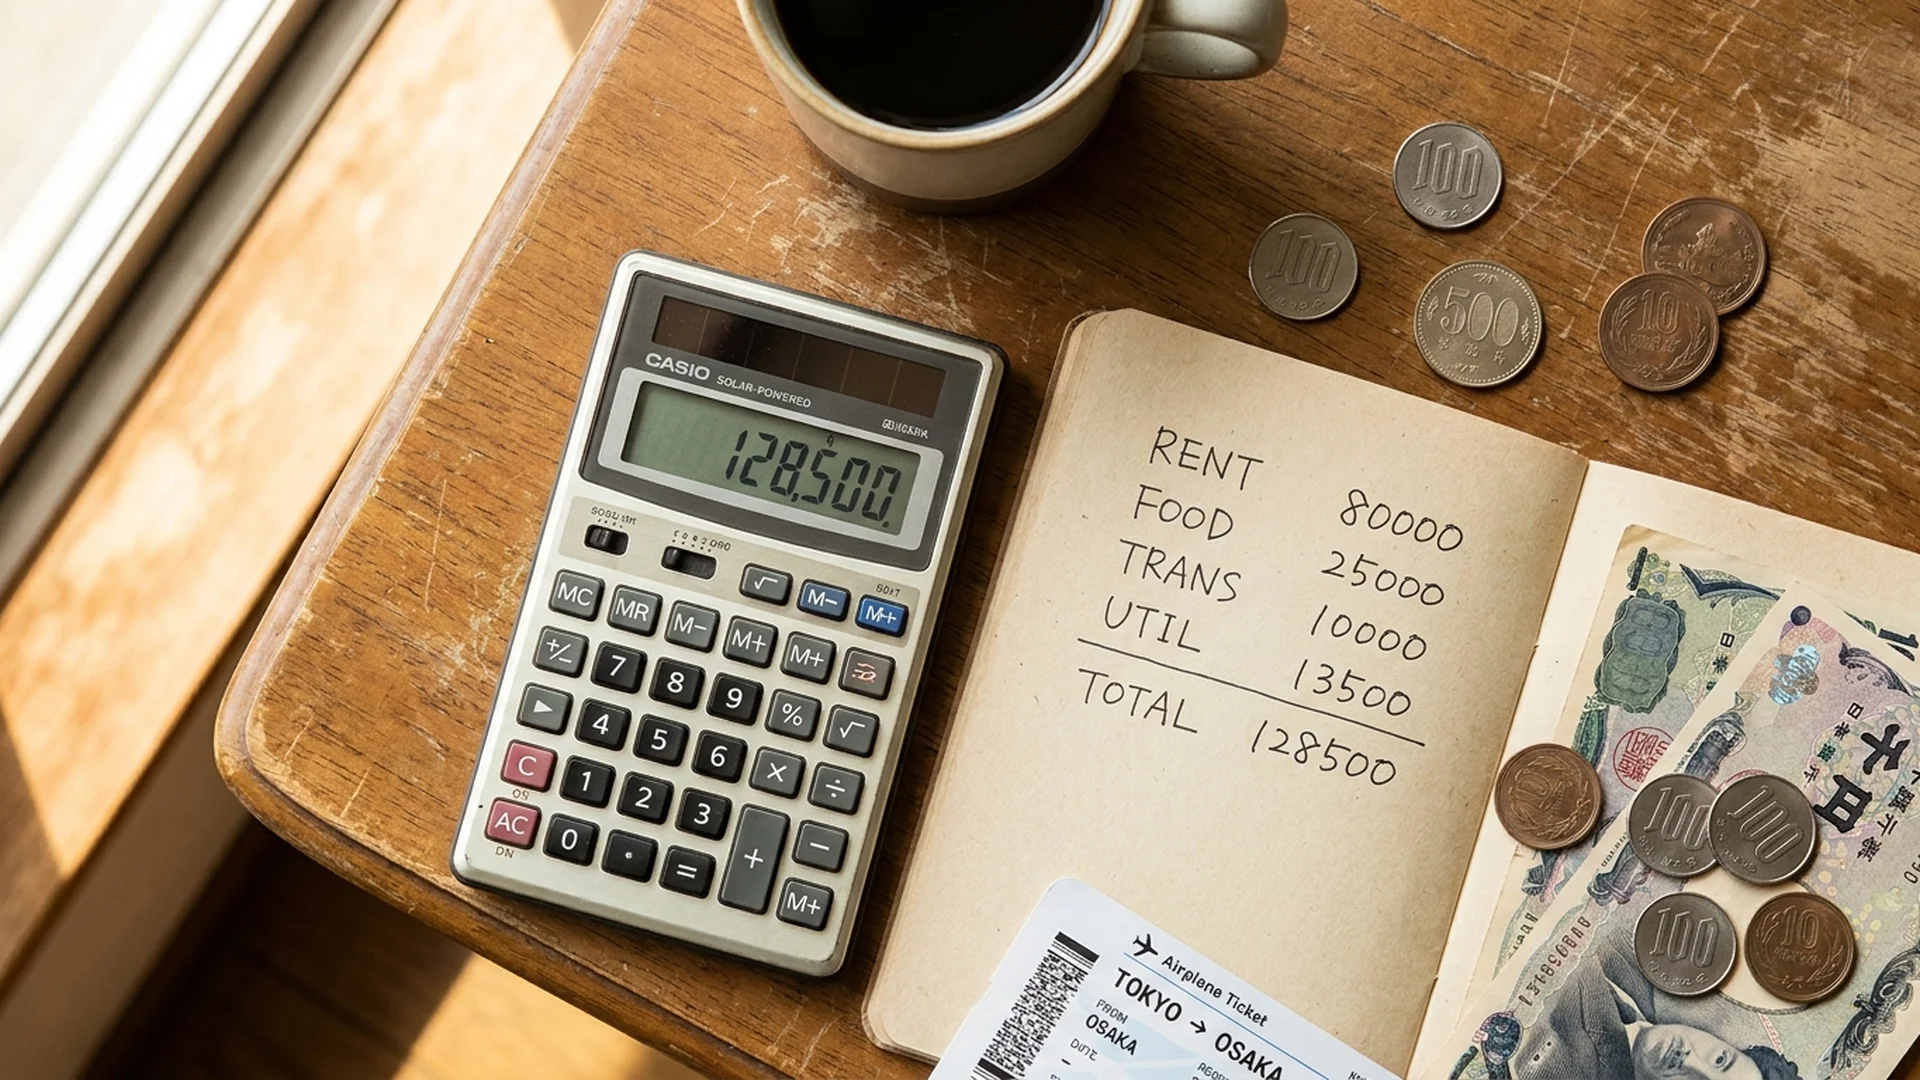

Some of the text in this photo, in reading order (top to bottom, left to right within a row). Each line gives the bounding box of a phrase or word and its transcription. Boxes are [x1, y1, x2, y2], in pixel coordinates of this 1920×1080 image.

[1412, 138, 1484, 200] 100
[1265, 229, 1341, 293] 100
[1440, 286, 1519, 347] 500
[1637, 289, 1680, 334] 10
[645, 353, 812, 409] CASIO SOLAR-POWERED
[1149, 426, 1464, 551] RENT 80000
[1133, 484, 1445, 606] FOOD 25000
[556, 581, 594, 607] MC
[1120, 539, 1427, 661] TRANS 10000
[616, 598, 650, 622] MR
[732, 628, 767, 652] M+
[611, 655, 628, 677] 7
[789, 645, 825, 667] M+
[1104, 596, 1411, 716] UTIL 13500
[667, 672, 684, 694] 8
[726, 687, 743, 710] 9
[591, 713, 610, 735] 4
[782, 703, 804, 726] %
[1078, 668, 1397, 785] TOTAL 128500
[651, 729, 668, 751] 5
[518, 756, 538, 777] C
[709, 747, 726, 768] 6
[580, 771, 594, 793] 1
[634, 787, 652, 810] 2
[495, 812, 529, 835] AC
[693, 804, 710, 825] 3
[1727, 784, 1805, 864] 100
[560, 828, 579, 851] 0
[787, 892, 822, 916] M+
[1650, 907, 1719, 968] 100
[1780, 905, 1820, 949] 10
[1113, 966, 1285, 1080] TOKYO OSAKA
[1227, 992, 1270, 1029] Ticket
[1085, 1014, 1139, 1057] OSAKA
